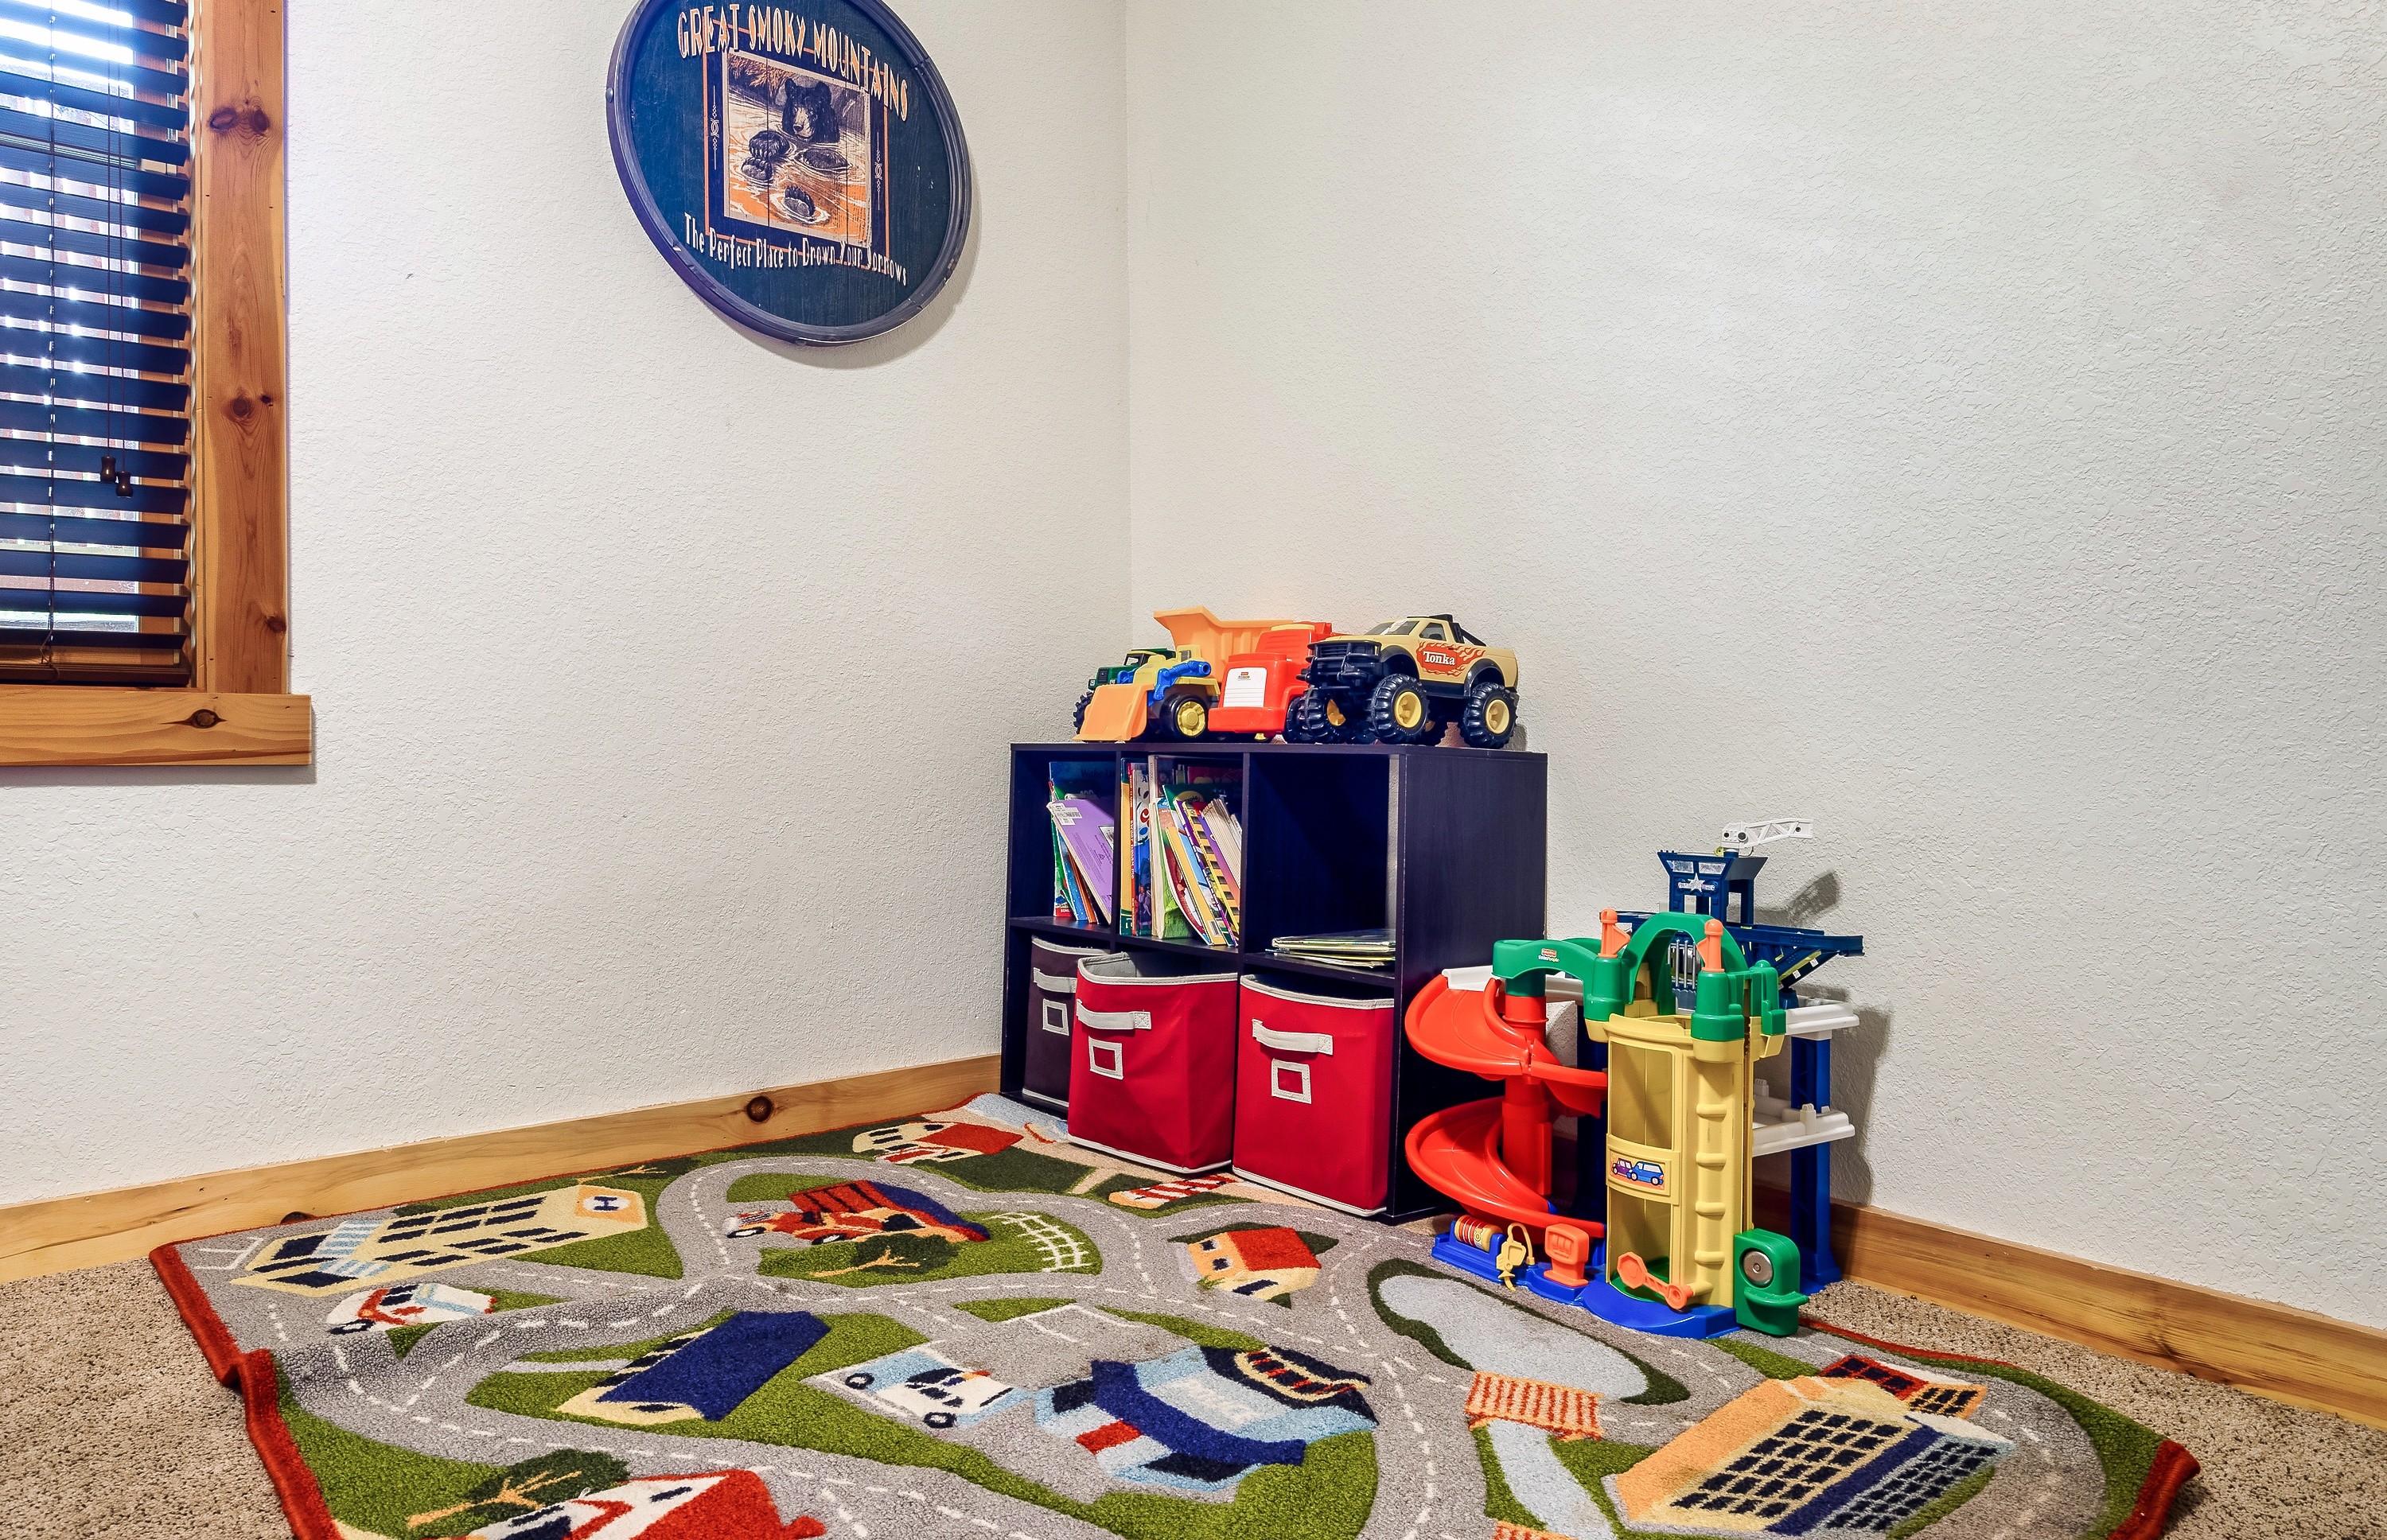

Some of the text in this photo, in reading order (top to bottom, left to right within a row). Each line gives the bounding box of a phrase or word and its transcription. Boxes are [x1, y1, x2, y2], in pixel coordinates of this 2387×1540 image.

[678, 4, 908, 122] GREAT SMOKY MOUNTAINS
[684, 212, 907, 286] The Perfect Place to Drown Your Sorrows
[1423, 650, 1456, 666] Tonka
